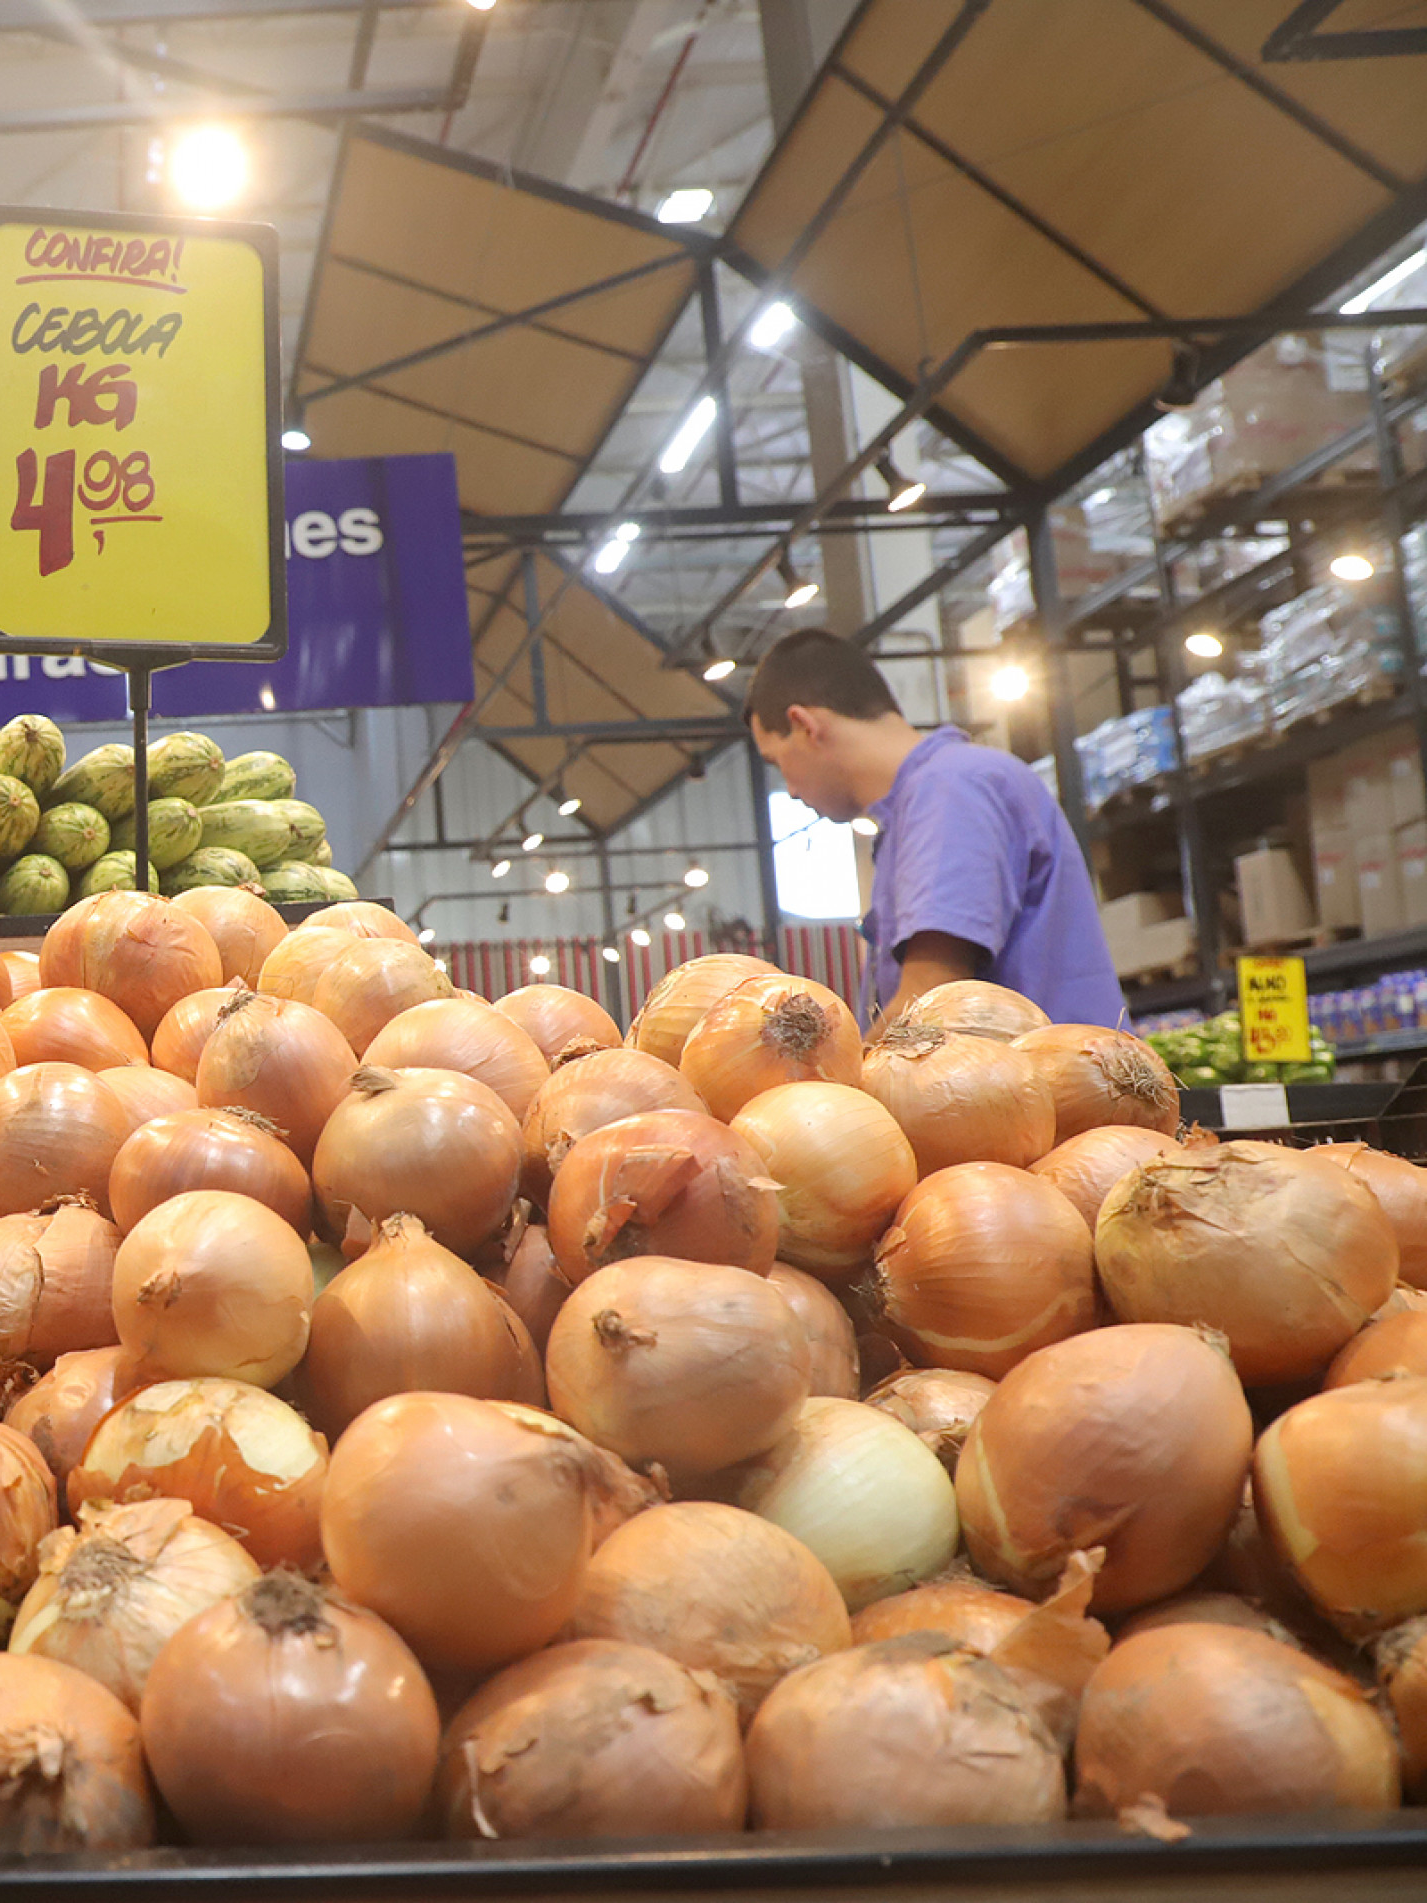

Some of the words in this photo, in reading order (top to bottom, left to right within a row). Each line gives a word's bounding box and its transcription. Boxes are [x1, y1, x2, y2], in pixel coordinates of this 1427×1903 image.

[24, 227, 185, 283] CONFIRA!
[12, 302, 183, 358] CEBOLA
[34, 363, 138, 431] KG
